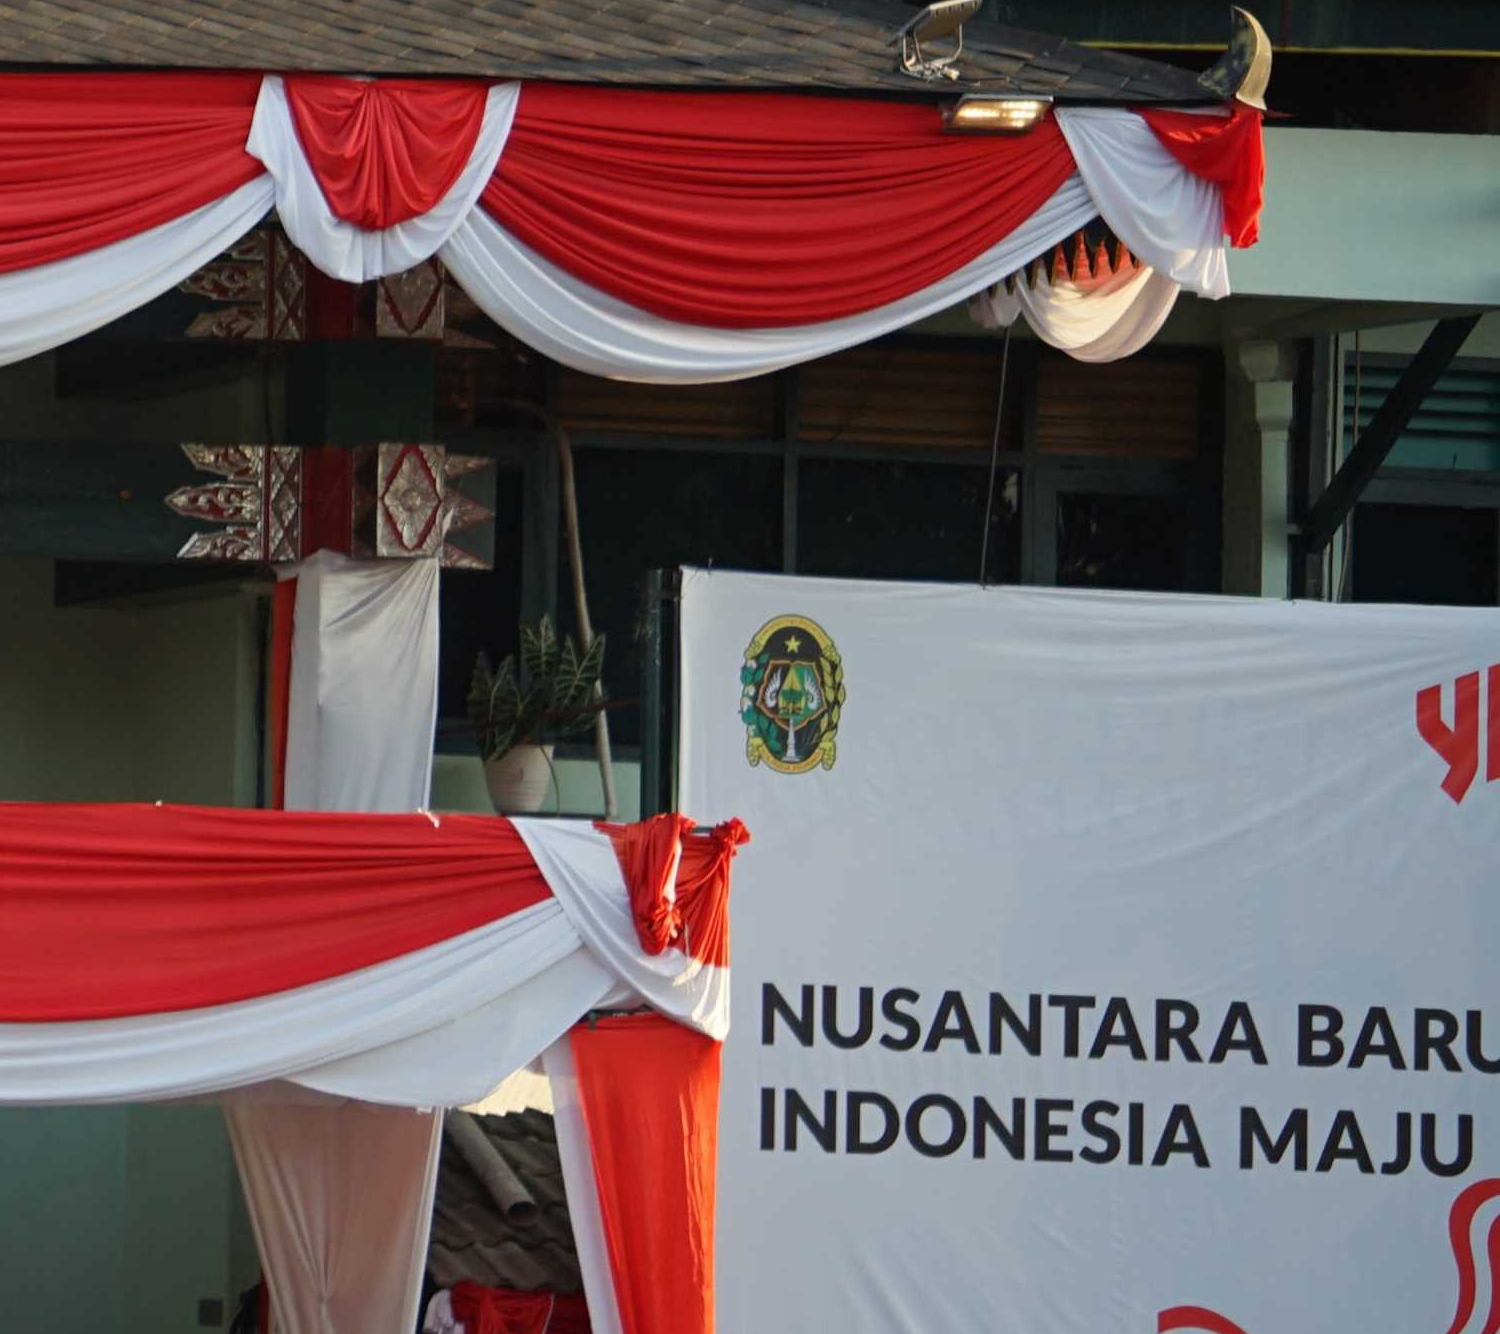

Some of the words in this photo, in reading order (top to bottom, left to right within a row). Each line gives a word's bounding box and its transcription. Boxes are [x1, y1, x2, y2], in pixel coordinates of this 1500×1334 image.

[762, 983, 1268, 1066] NUSANTARA
[1297, 1004, 1500, 1075] BARU
[760, 1088, 1211, 1169] INDONESIA
[1239, 1107, 1474, 1178] MAJU
